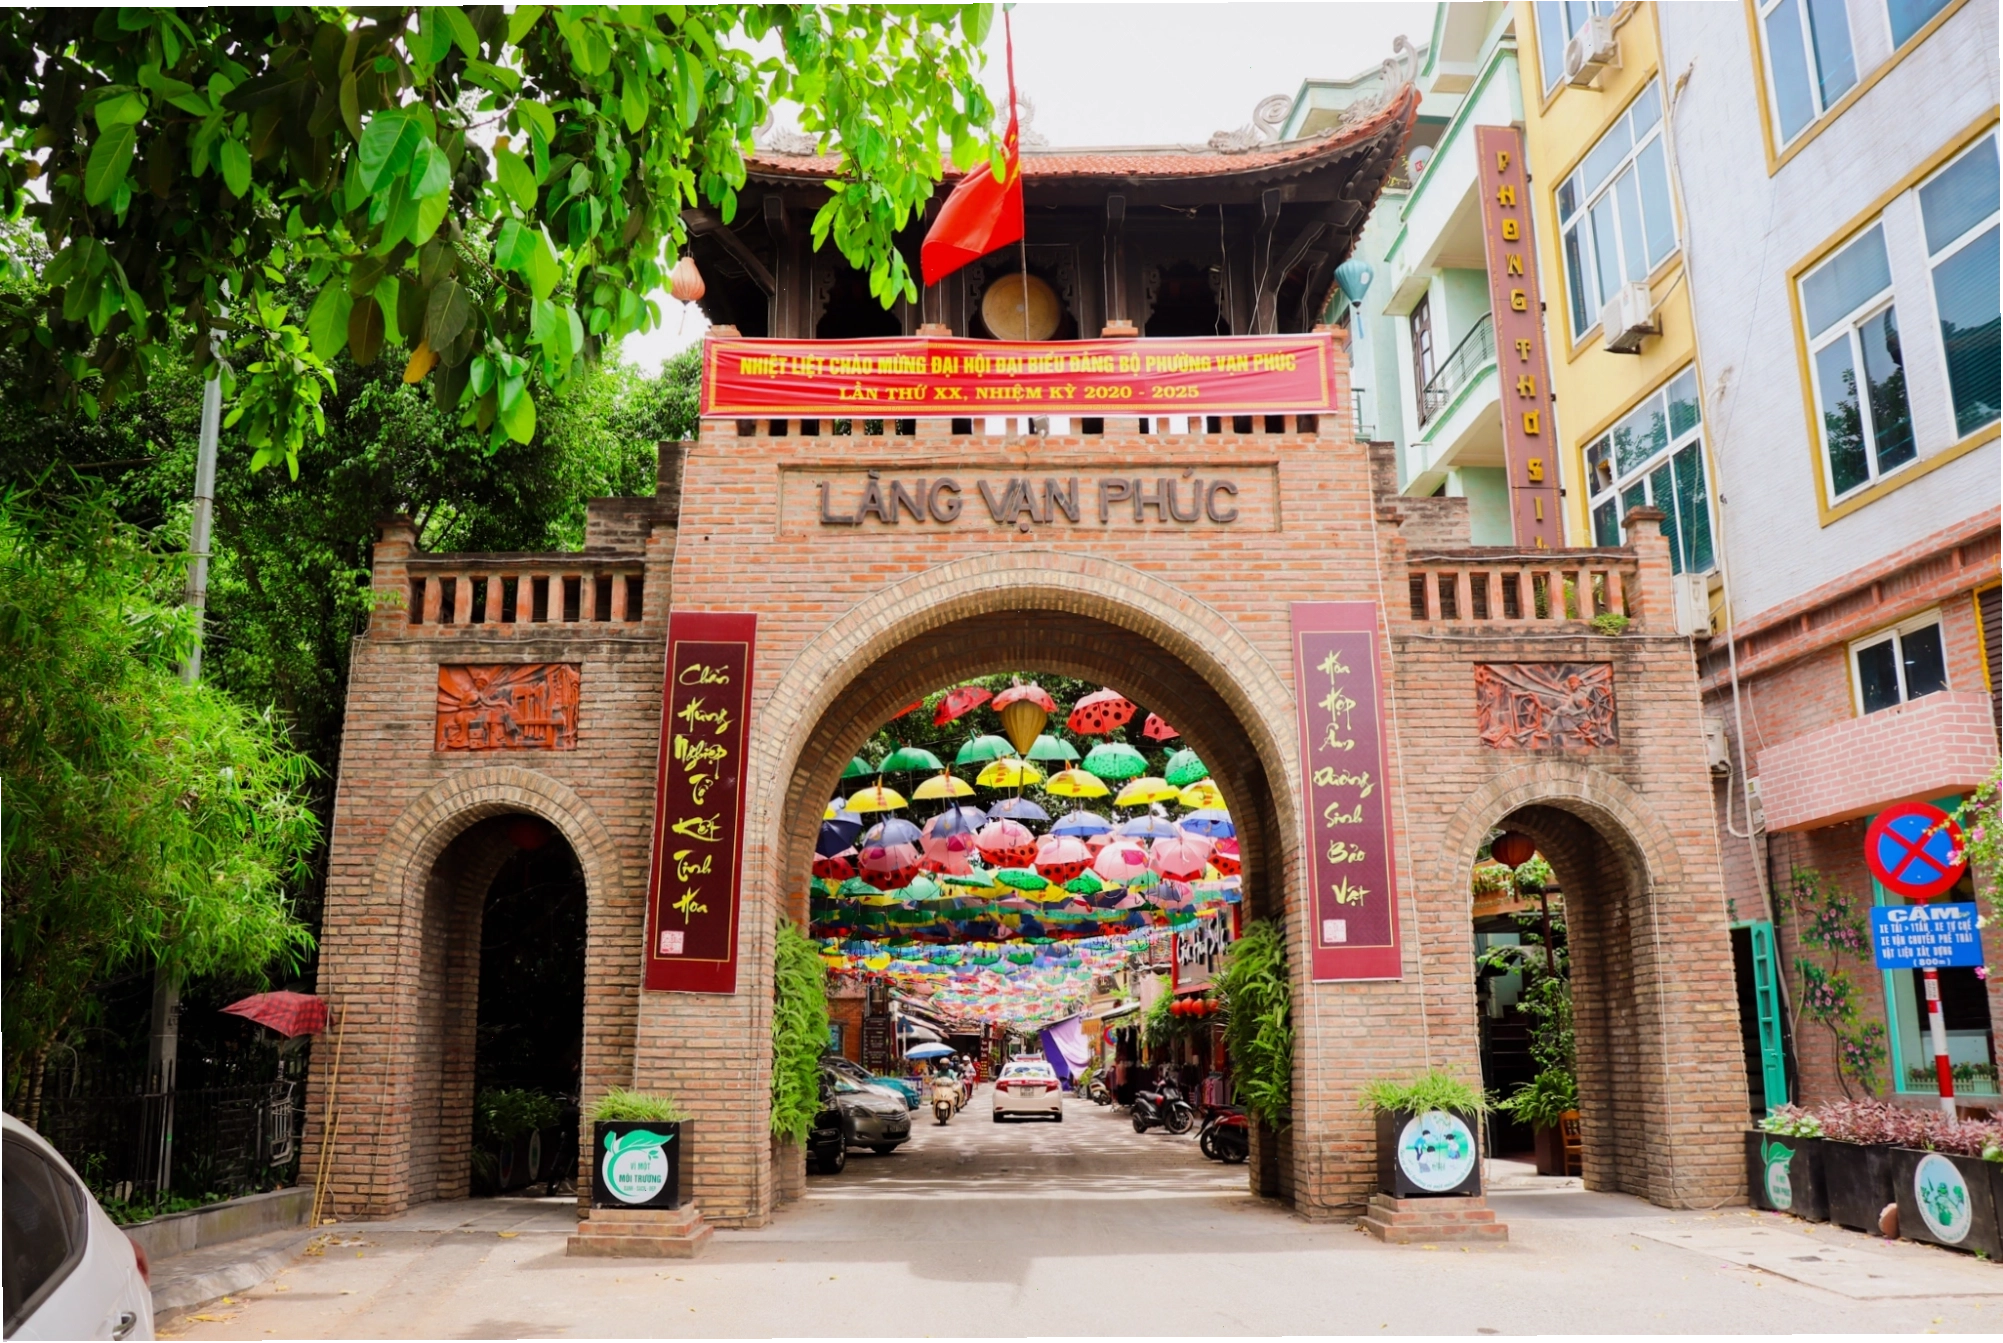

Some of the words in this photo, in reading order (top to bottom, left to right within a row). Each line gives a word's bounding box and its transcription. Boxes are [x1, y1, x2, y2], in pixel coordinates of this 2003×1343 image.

[740, 353, 787, 378] NHIỆT
[792, 353, 825, 378] LIỆT
[829, 353, 872, 375] CHÀO
[877, 353, 927, 374] MỪNG
[931, 356, 958, 378] ĐẠI
[964, 353, 990, 378] HỘI
[995, 356, 1023, 378] ĐẠI
[1119, 352, 1141, 377] BỘ
[1145, 352, 1211, 373] PHƯỜNG
[1216, 354, 1249, 376] VẠN
[1253, 350, 1296, 372] PHÚC
[839, 381, 879, 400] LẦN
[885, 384, 928, 400] THỨ
[933, 386, 968, 401] XX,
[975, 383, 1042, 402] NHIỆM
[1050, 383, 1077, 400] KỲ
[1084, 386, 1132, 399] 2020
[1152, 385, 1200, 399] 2025
[820, 469, 964, 523] LÀNG
[977, 477, 1081, 533] VẠN
[1100, 467, 1240, 523] PHÚC
[1879, 924, 1889, 933] XE
[1935, 922, 1945, 932] XE
[1881, 936, 1890, 946] XE
[619, 1173, 632, 1183] MÔI
[634, 1173, 661, 1183] TRƯỜNG
